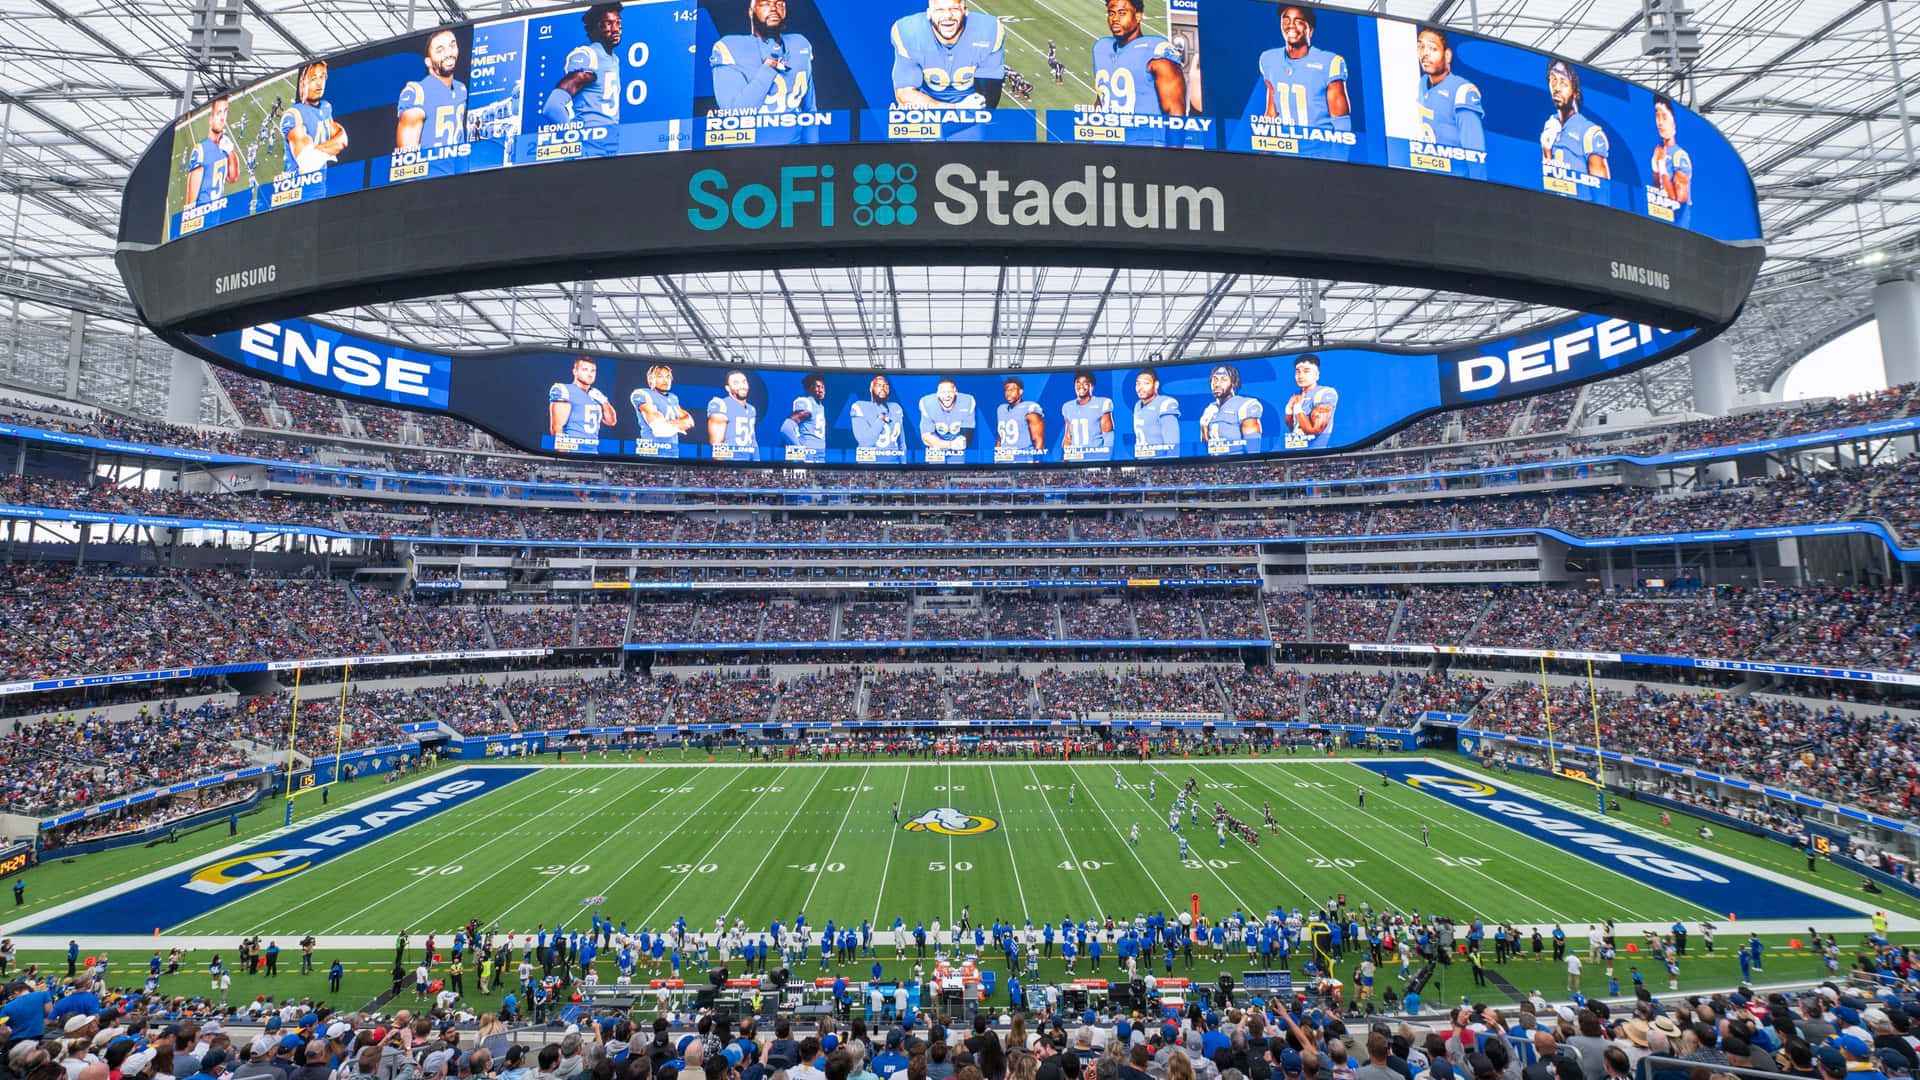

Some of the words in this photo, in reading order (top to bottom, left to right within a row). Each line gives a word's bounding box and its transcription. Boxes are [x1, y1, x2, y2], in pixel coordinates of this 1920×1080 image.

[540, 26, 552, 35] Q1
[628, 42, 650, 68] 0
[626, 80, 648, 105] 0
[1095, 67, 1136, 113] 69
[707, 107, 758, 118] A'SHAWN
[1277, 82, 1308, 126] 11
[706, 112, 832, 131] ROBINSON
[888, 110, 992, 123] DONALD
[1074, 113, 1212, 131] JOSEPH-DAY
[537, 127, 608, 146] FLOYD
[538, 121, 584, 133] LEONARD
[1251, 123, 1357, 145] WILLIAMS
[391, 143, 472, 168] HOLLINS
[1409, 141, 1488, 164] RAMSEY
[273, 172, 323, 194] YOUNG
[1543, 164, 1601, 188] FULLER
[687, 163, 834, 231] SoFi
[934, 163, 1225, 232] Stadium
[1647, 193, 1681, 211] RAPP
[182, 198, 228, 223] REEDER
[215, 264, 276, 294] SAMSUNG
[1610, 261, 1670, 290] SAMSUNG
[239, 322, 431, 397] ENSE
[303, 775, 313, 786] 15
[303, 779, 486, 846] RAMS
[1465, 798, 1731, 884] RAMS
[411, 865, 464, 876] 10
[540, 864, 591, 875] 20
[669, 863, 719, 874] 30
[799, 862, 847, 873] 40
[928, 861, 974, 872] 50
[1056, 860, 1101, 871] 40
[1184, 859, 1231, 870] 30
[1308, 858, 1348, 868] 20
[1432, 856, 1483, 867] 10
